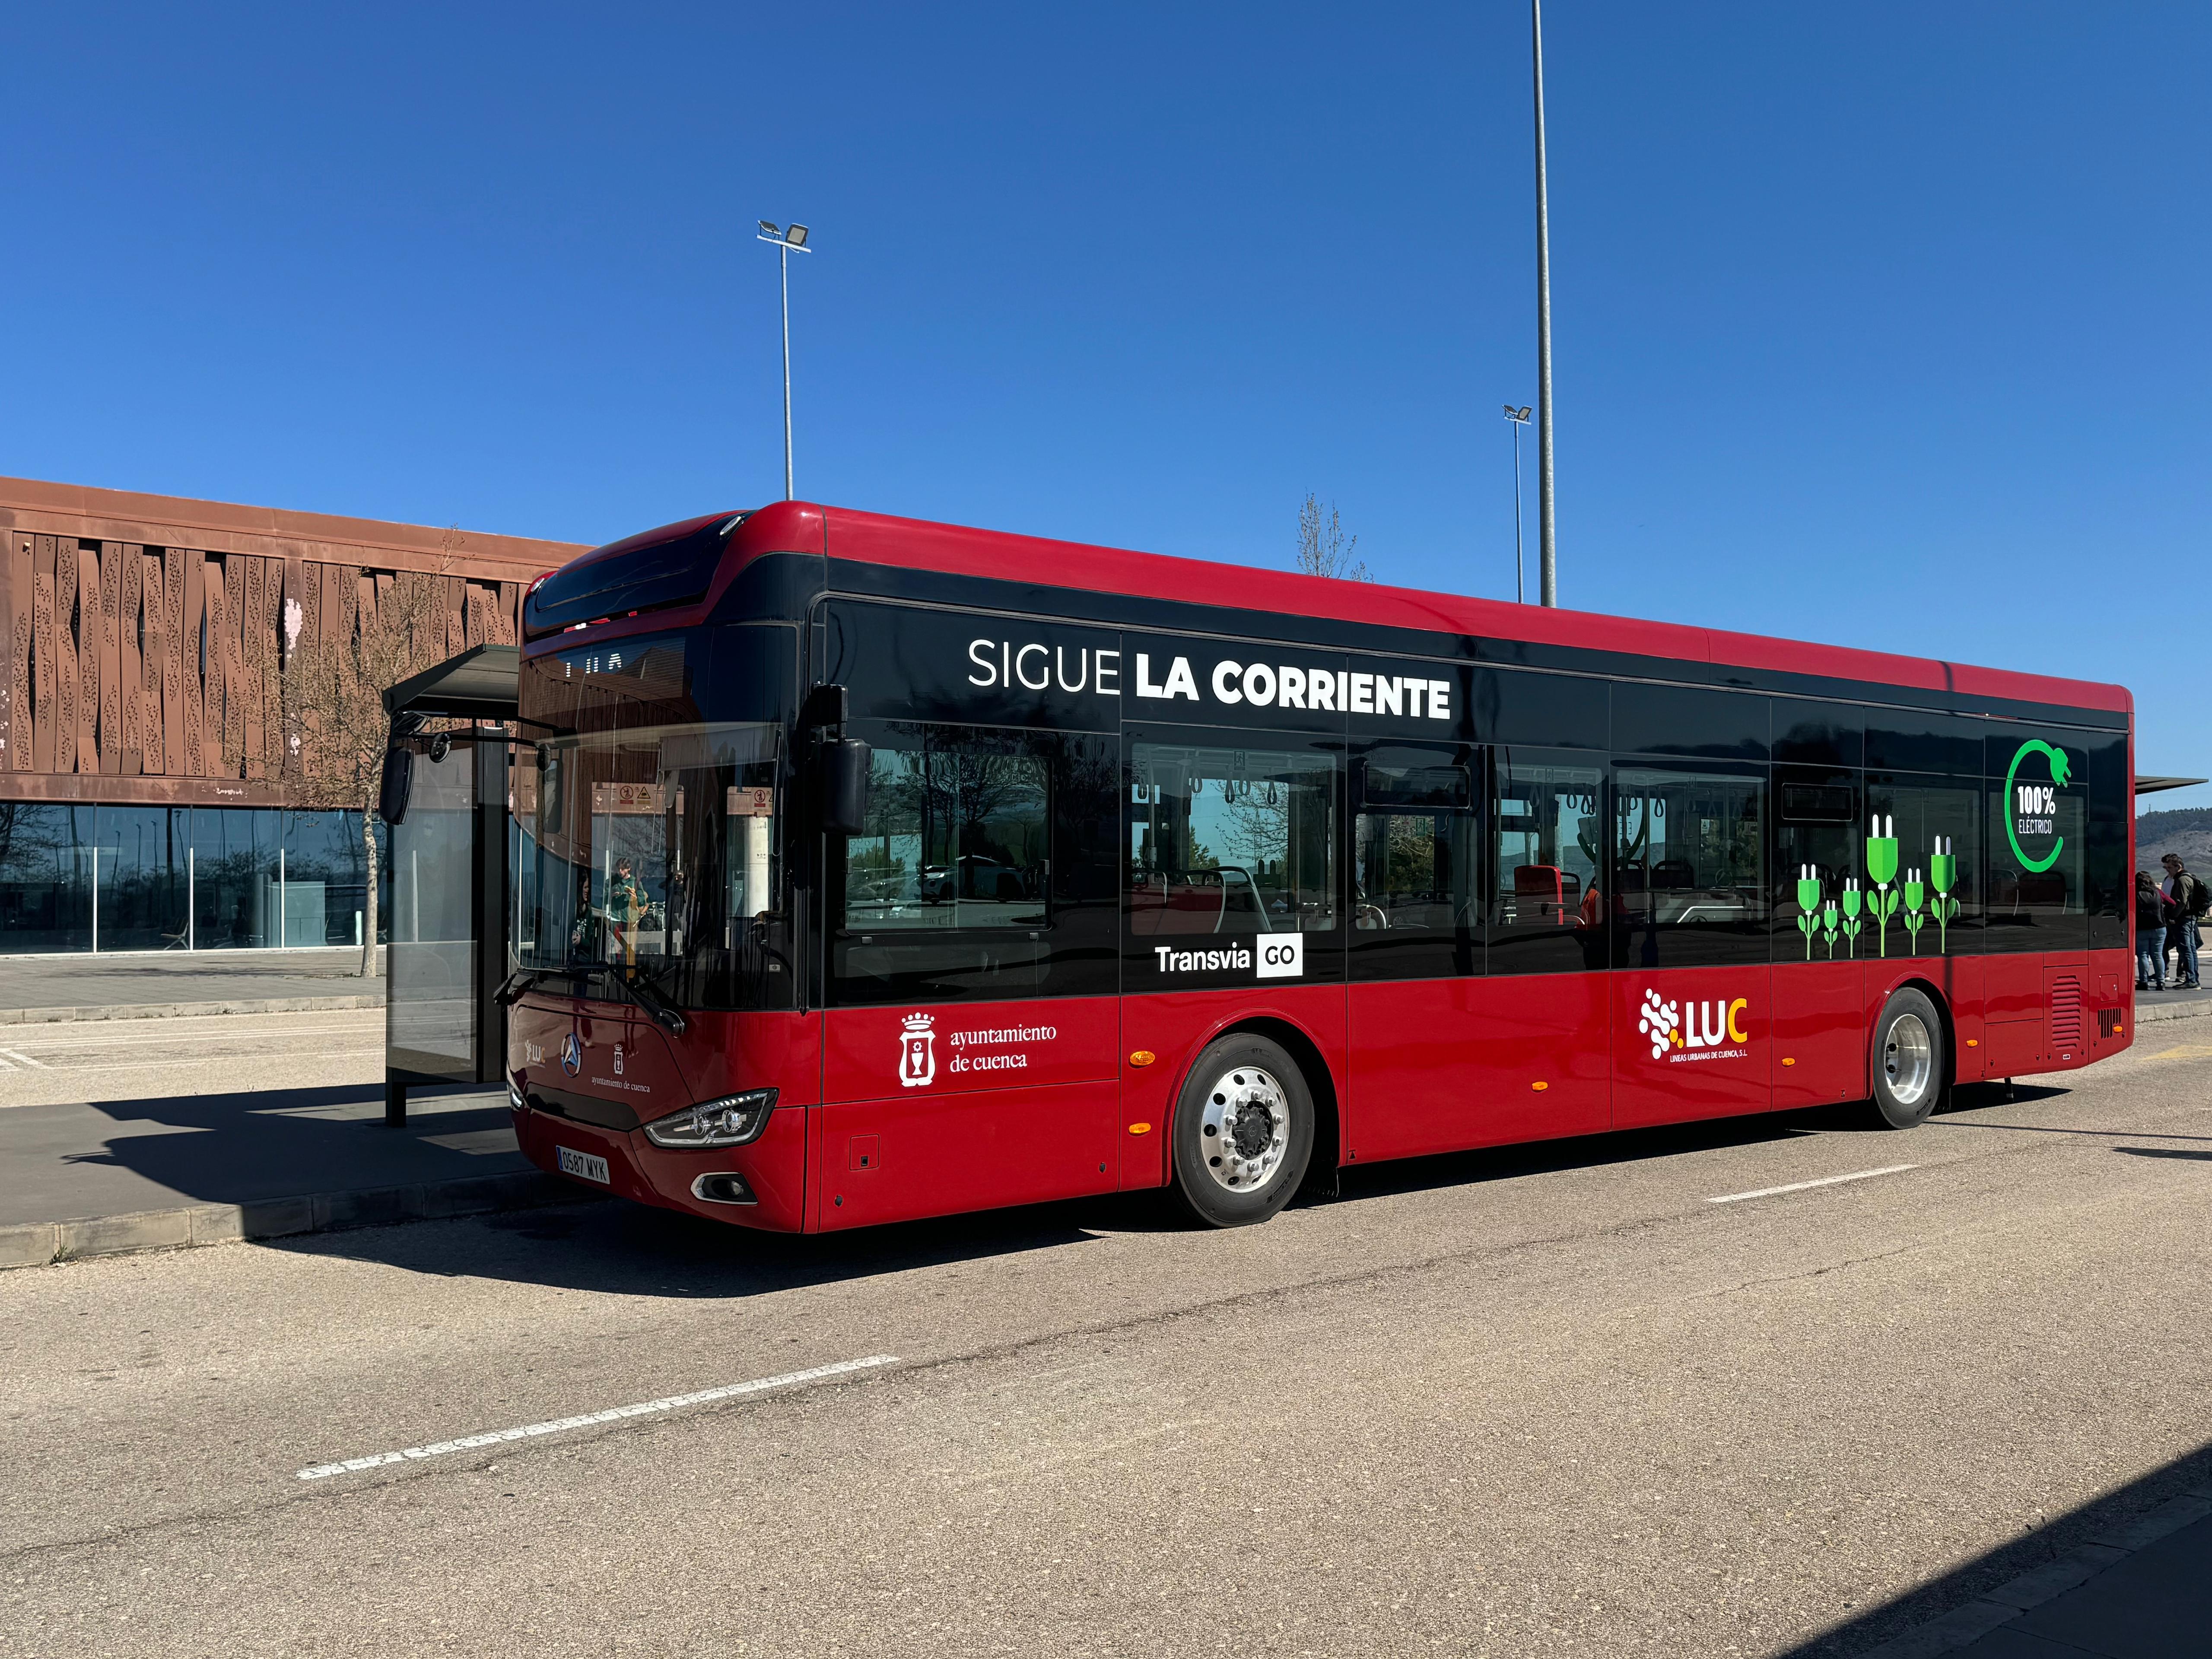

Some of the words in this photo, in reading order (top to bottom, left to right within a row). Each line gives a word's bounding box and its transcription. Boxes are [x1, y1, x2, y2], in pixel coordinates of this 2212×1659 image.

[969, 639, 1120, 695] SIGUE
[1136, 653, 1200, 701] LA
[1212, 660, 1450, 719] CORRIENTE
[2018, 785, 2056, 814] 100%
[2018, 816, 2052, 834] ELÉCTRICO
[1154, 941, 1250, 972] Transvia
[1265, 945, 1295, 965] GO
[1686, 998, 1748, 1047] LUC
[950, 1023, 1057, 1051] ayuntamiento
[532, 1044, 546, 1063] LUC
[950, 1054, 969, 1073] de
[973, 1053, 1027, 1071] cuenca
[1687, 1052, 1710, 1061] URBANAS
[591, 1077, 622, 1088] ayuntamiento
[623, 1081, 630, 1090] de
[631, 1083, 650, 1093] cuenca
[563, 1151, 583, 1174] 0587
[586, 1157, 607, 1181] MYK
